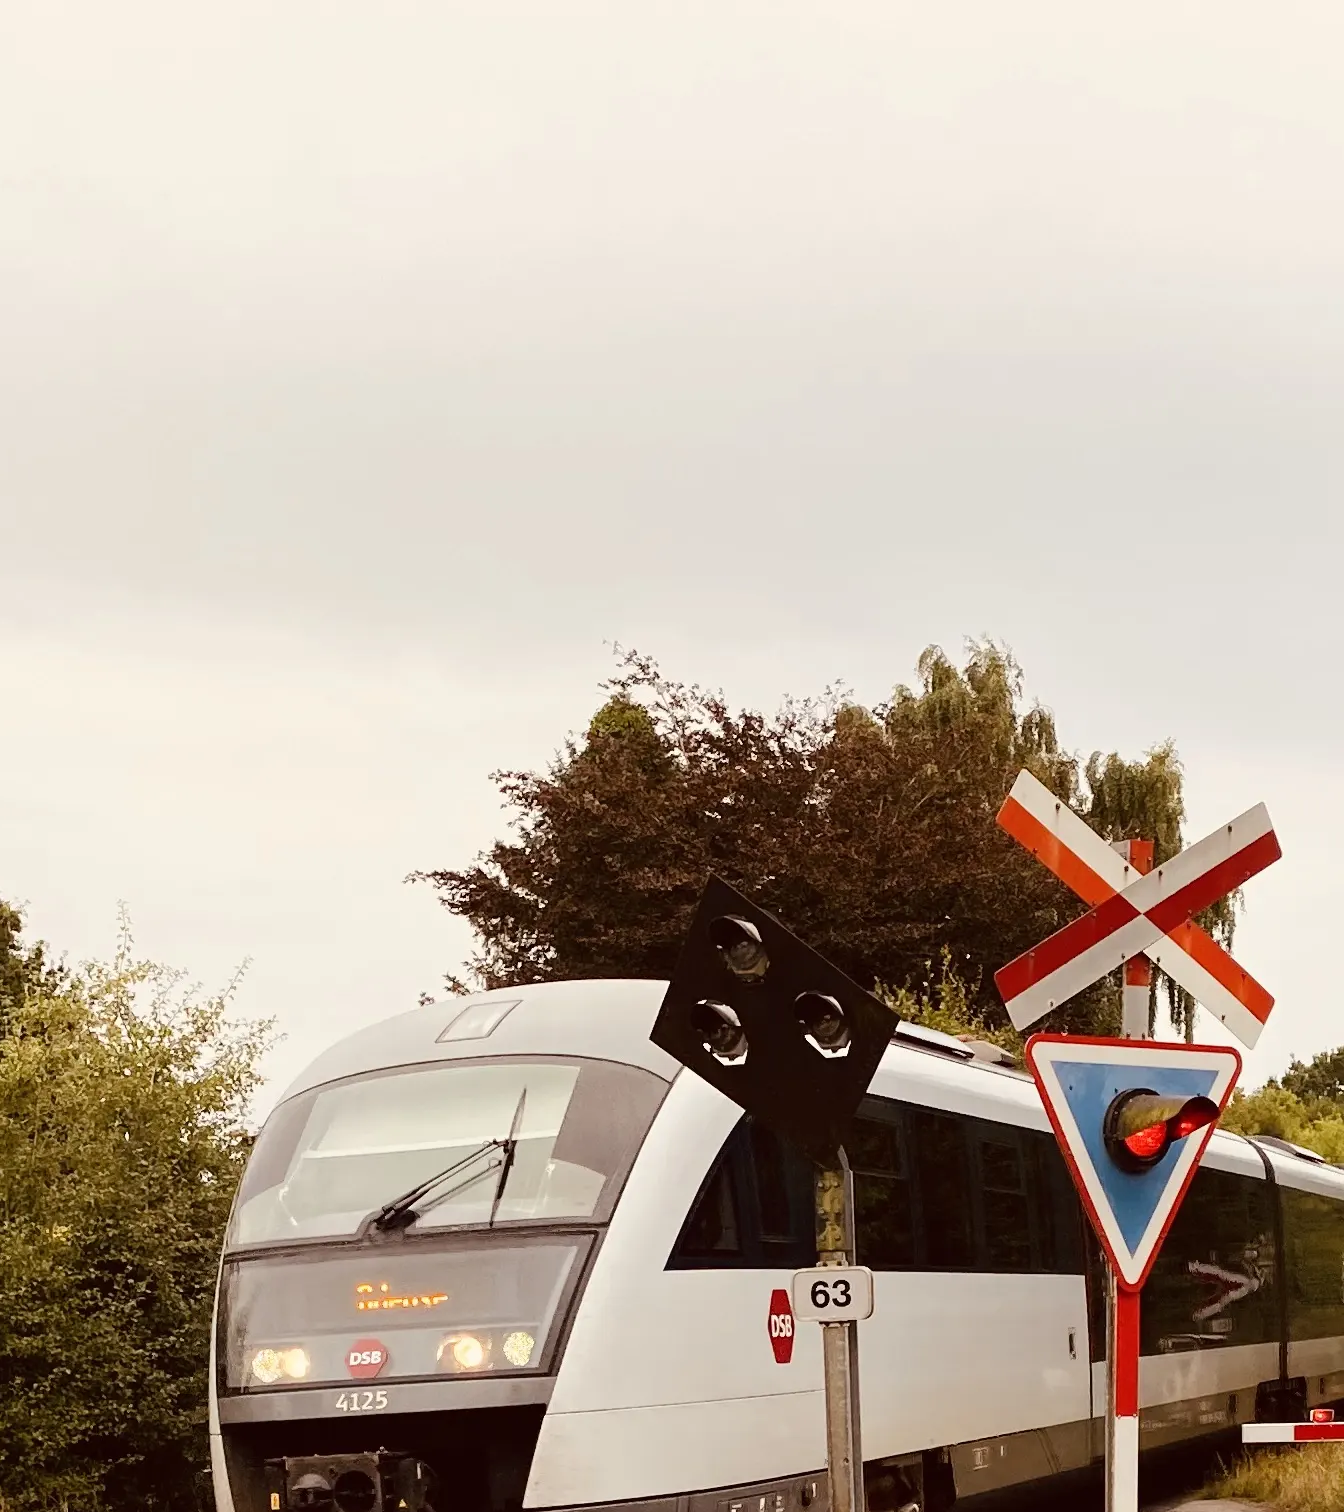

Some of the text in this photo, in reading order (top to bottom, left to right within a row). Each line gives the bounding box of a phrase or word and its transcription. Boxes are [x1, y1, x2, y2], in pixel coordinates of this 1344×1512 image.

[810, 1279, 852, 1309] 63
[770, 1313, 793, 1338] DSB
[349, 1350, 382, 1366] DSB
[335, 1390, 388, 1412] 4125
